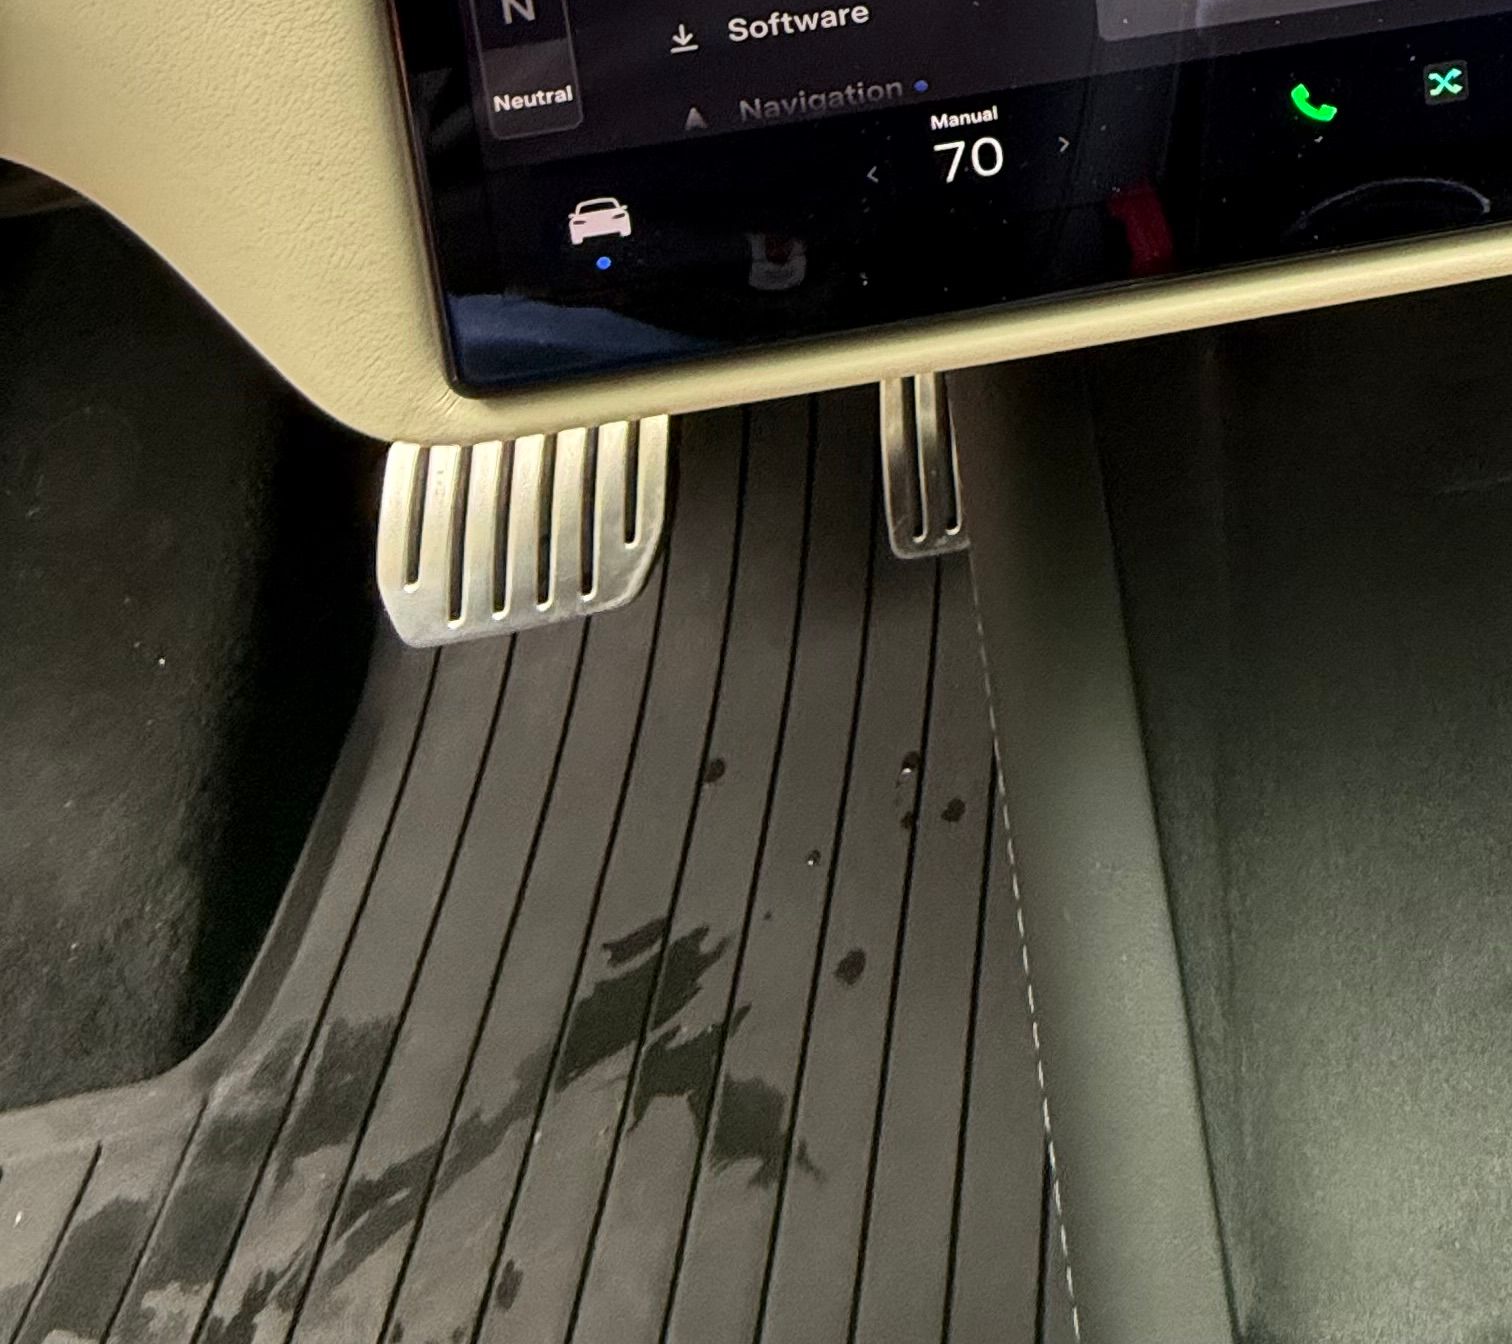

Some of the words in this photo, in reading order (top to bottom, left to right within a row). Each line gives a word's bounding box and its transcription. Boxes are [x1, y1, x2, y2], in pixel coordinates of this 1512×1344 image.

[728, 5, 869, 42] Software
[493, 84, 573, 113] Neutral
[739, 79, 903, 122] Navigation
[930, 105, 999, 130] Manual
[933, 137, 1004, 183] 70
